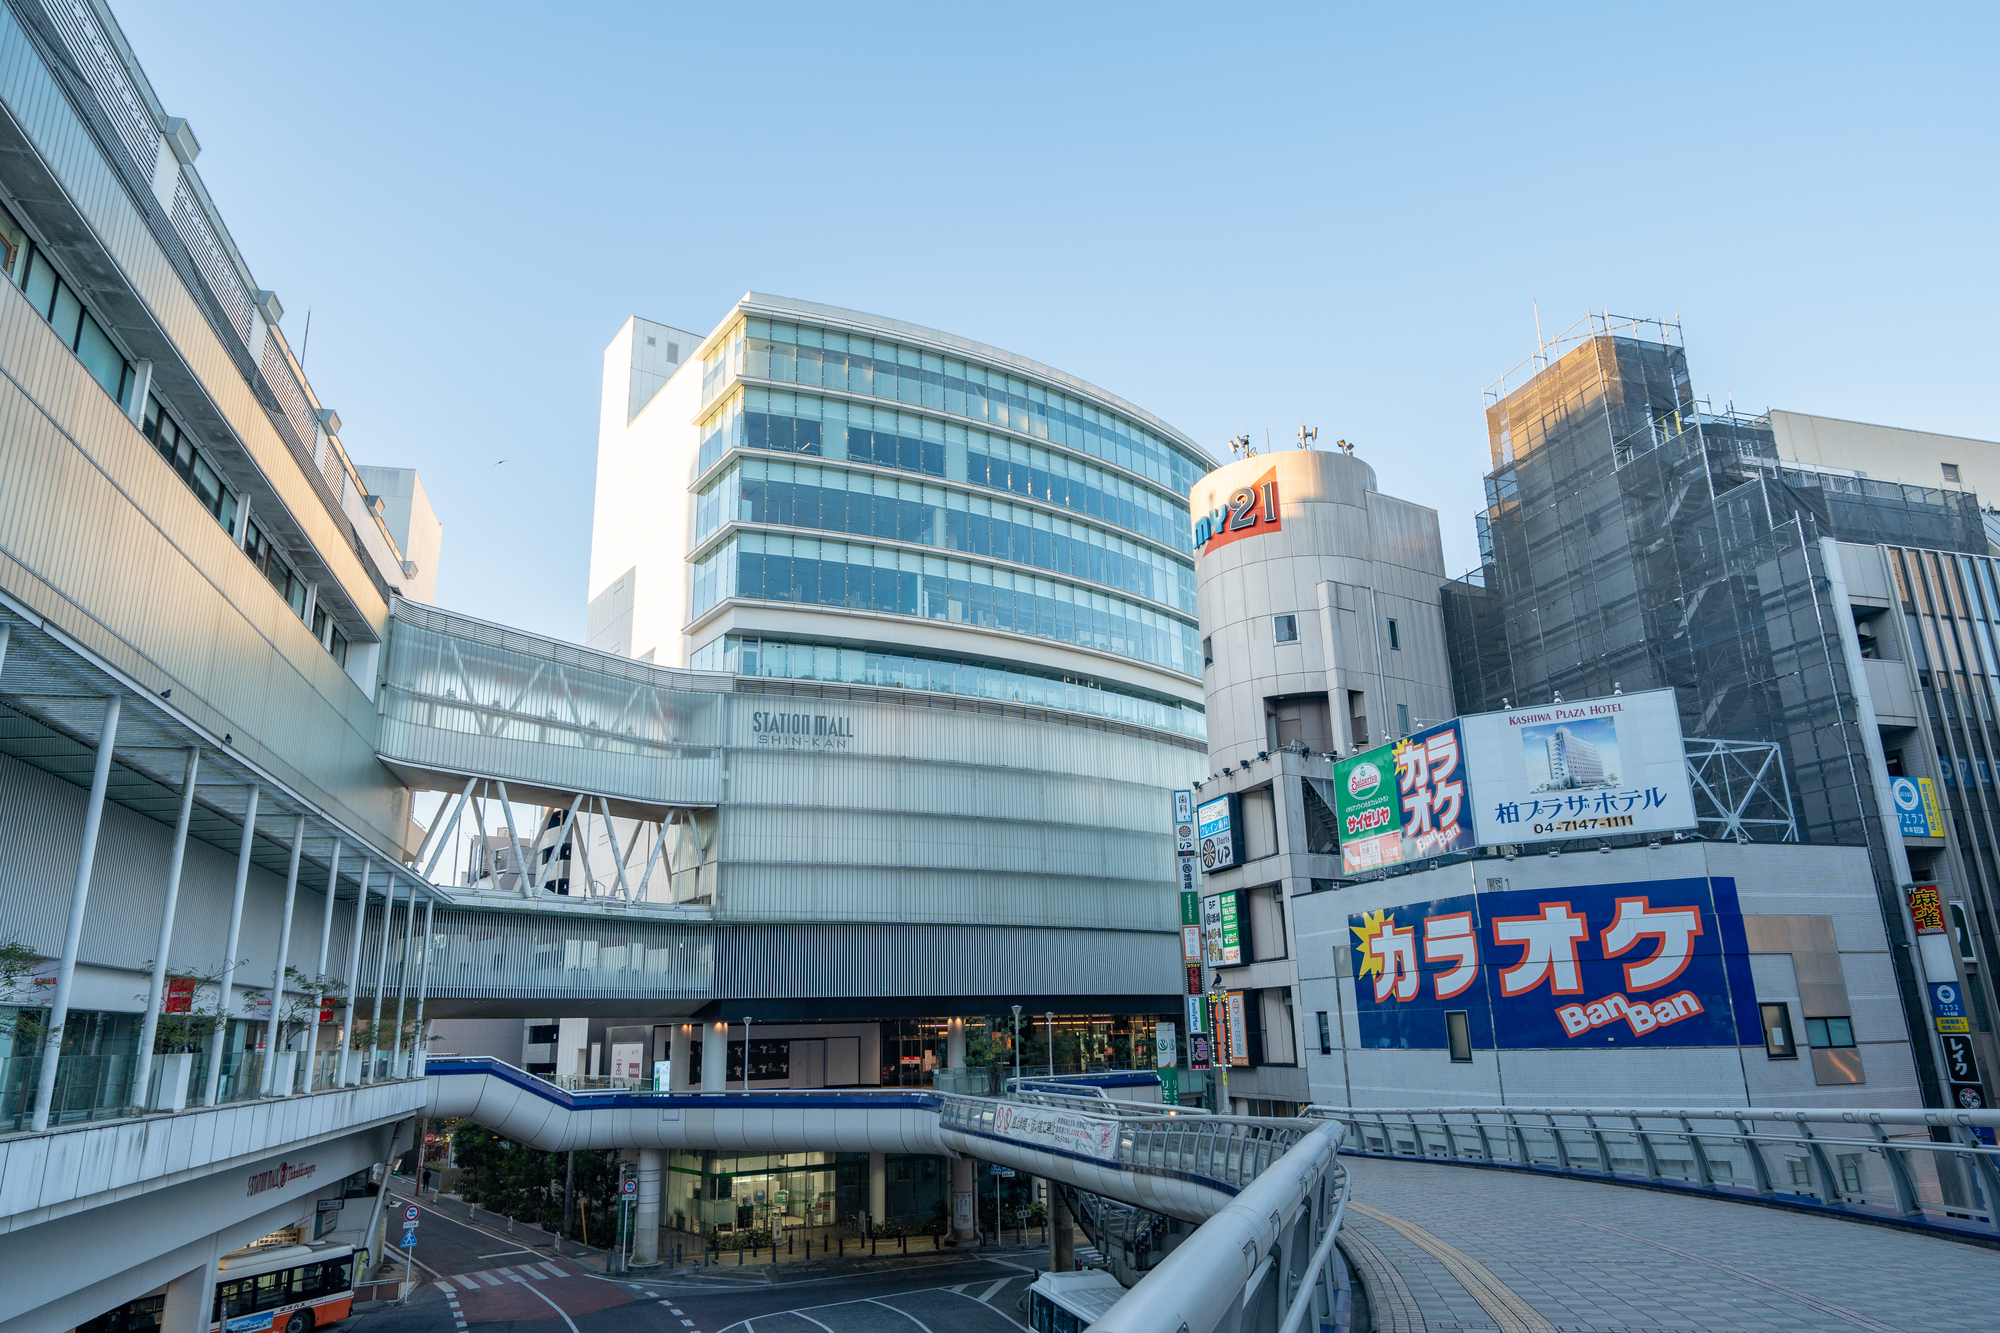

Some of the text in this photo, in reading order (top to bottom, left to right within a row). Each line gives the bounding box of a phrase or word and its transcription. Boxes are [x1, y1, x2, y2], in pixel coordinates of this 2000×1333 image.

[753, 711, 853, 737] STATION MALL
[1509, 703, 1624, 726] KASHIWA PLAZA HOTEL
[759, 735, 846, 749] SHIN-KAN
[1351, 774, 1378, 794] Saizeriya
[1178, 794, 1188, 813] 歯科
[1495, 787, 1668, 824] 柏プラザホテル
[1921, 784, 1937, 831] 賃貸専門店
[1200, 816, 1229, 836] クレイン歯科
[1347, 807, 1390, 834] サイゼリヤ
[1534, 815, 1634, 834] 04-7147-1111
[1897, 813, 1925, 825] アエラス
[1180, 842, 1192, 850] UP
[1217, 836, 1230, 846] Darts
[1217, 846, 1231, 864] UP
[1208, 900, 1216, 910] 5F
[1911, 889, 1943, 928] 麻雀
[1208, 940, 1223, 962] 99円
[1368, 896, 1704, 1003] カラオケ
[1189, 967, 1200, 994] ONE
[1190, 998, 1199, 1031] FamilyMart
[1555, 990, 1705, 1038] BanBan
[1950, 1038, 1968, 1076] レイク
[287, 1162, 316, 1181] Takashimaya
